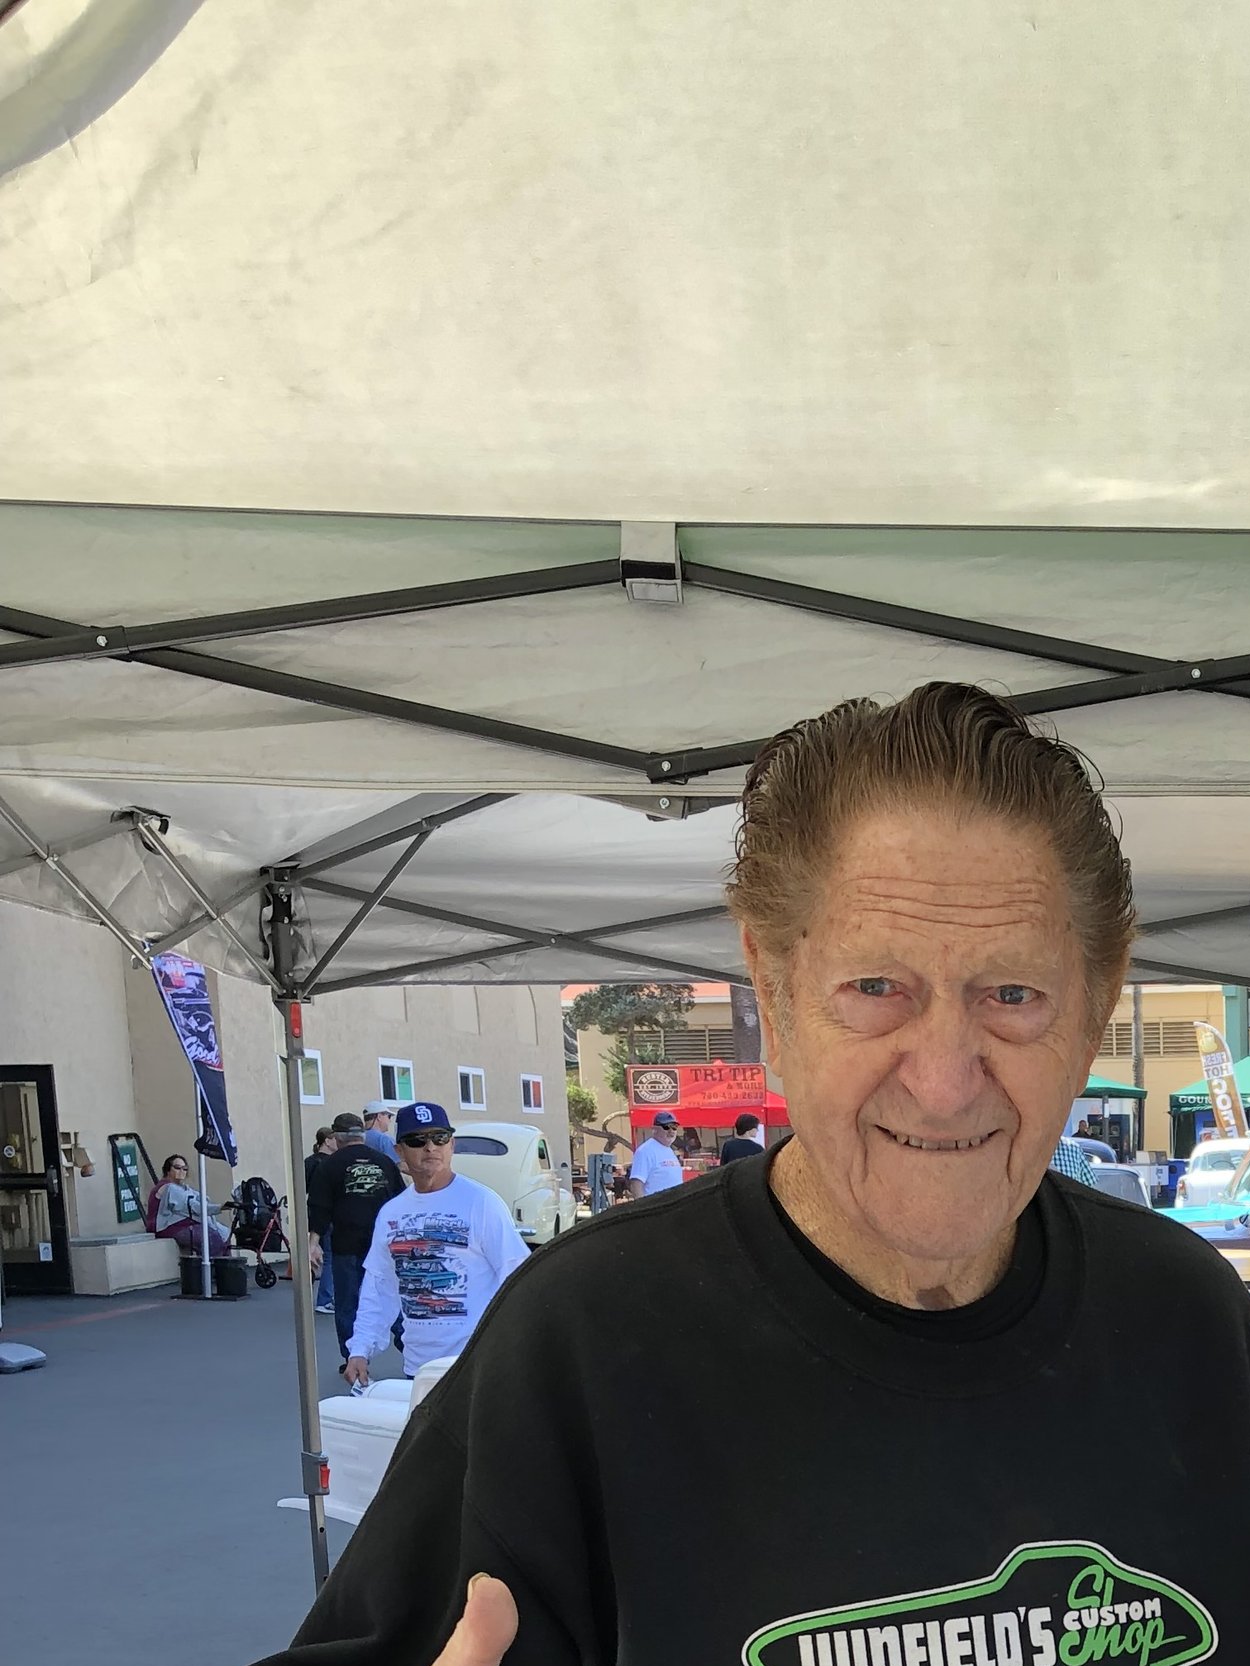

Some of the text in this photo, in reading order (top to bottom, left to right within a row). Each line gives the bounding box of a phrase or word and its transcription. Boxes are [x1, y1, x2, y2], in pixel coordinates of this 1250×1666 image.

[690, 1067, 761, 1082] TRI TIP
[415, 1105, 433, 1123] SD
[1062, 1597, 1161, 1632] CUSTOM
